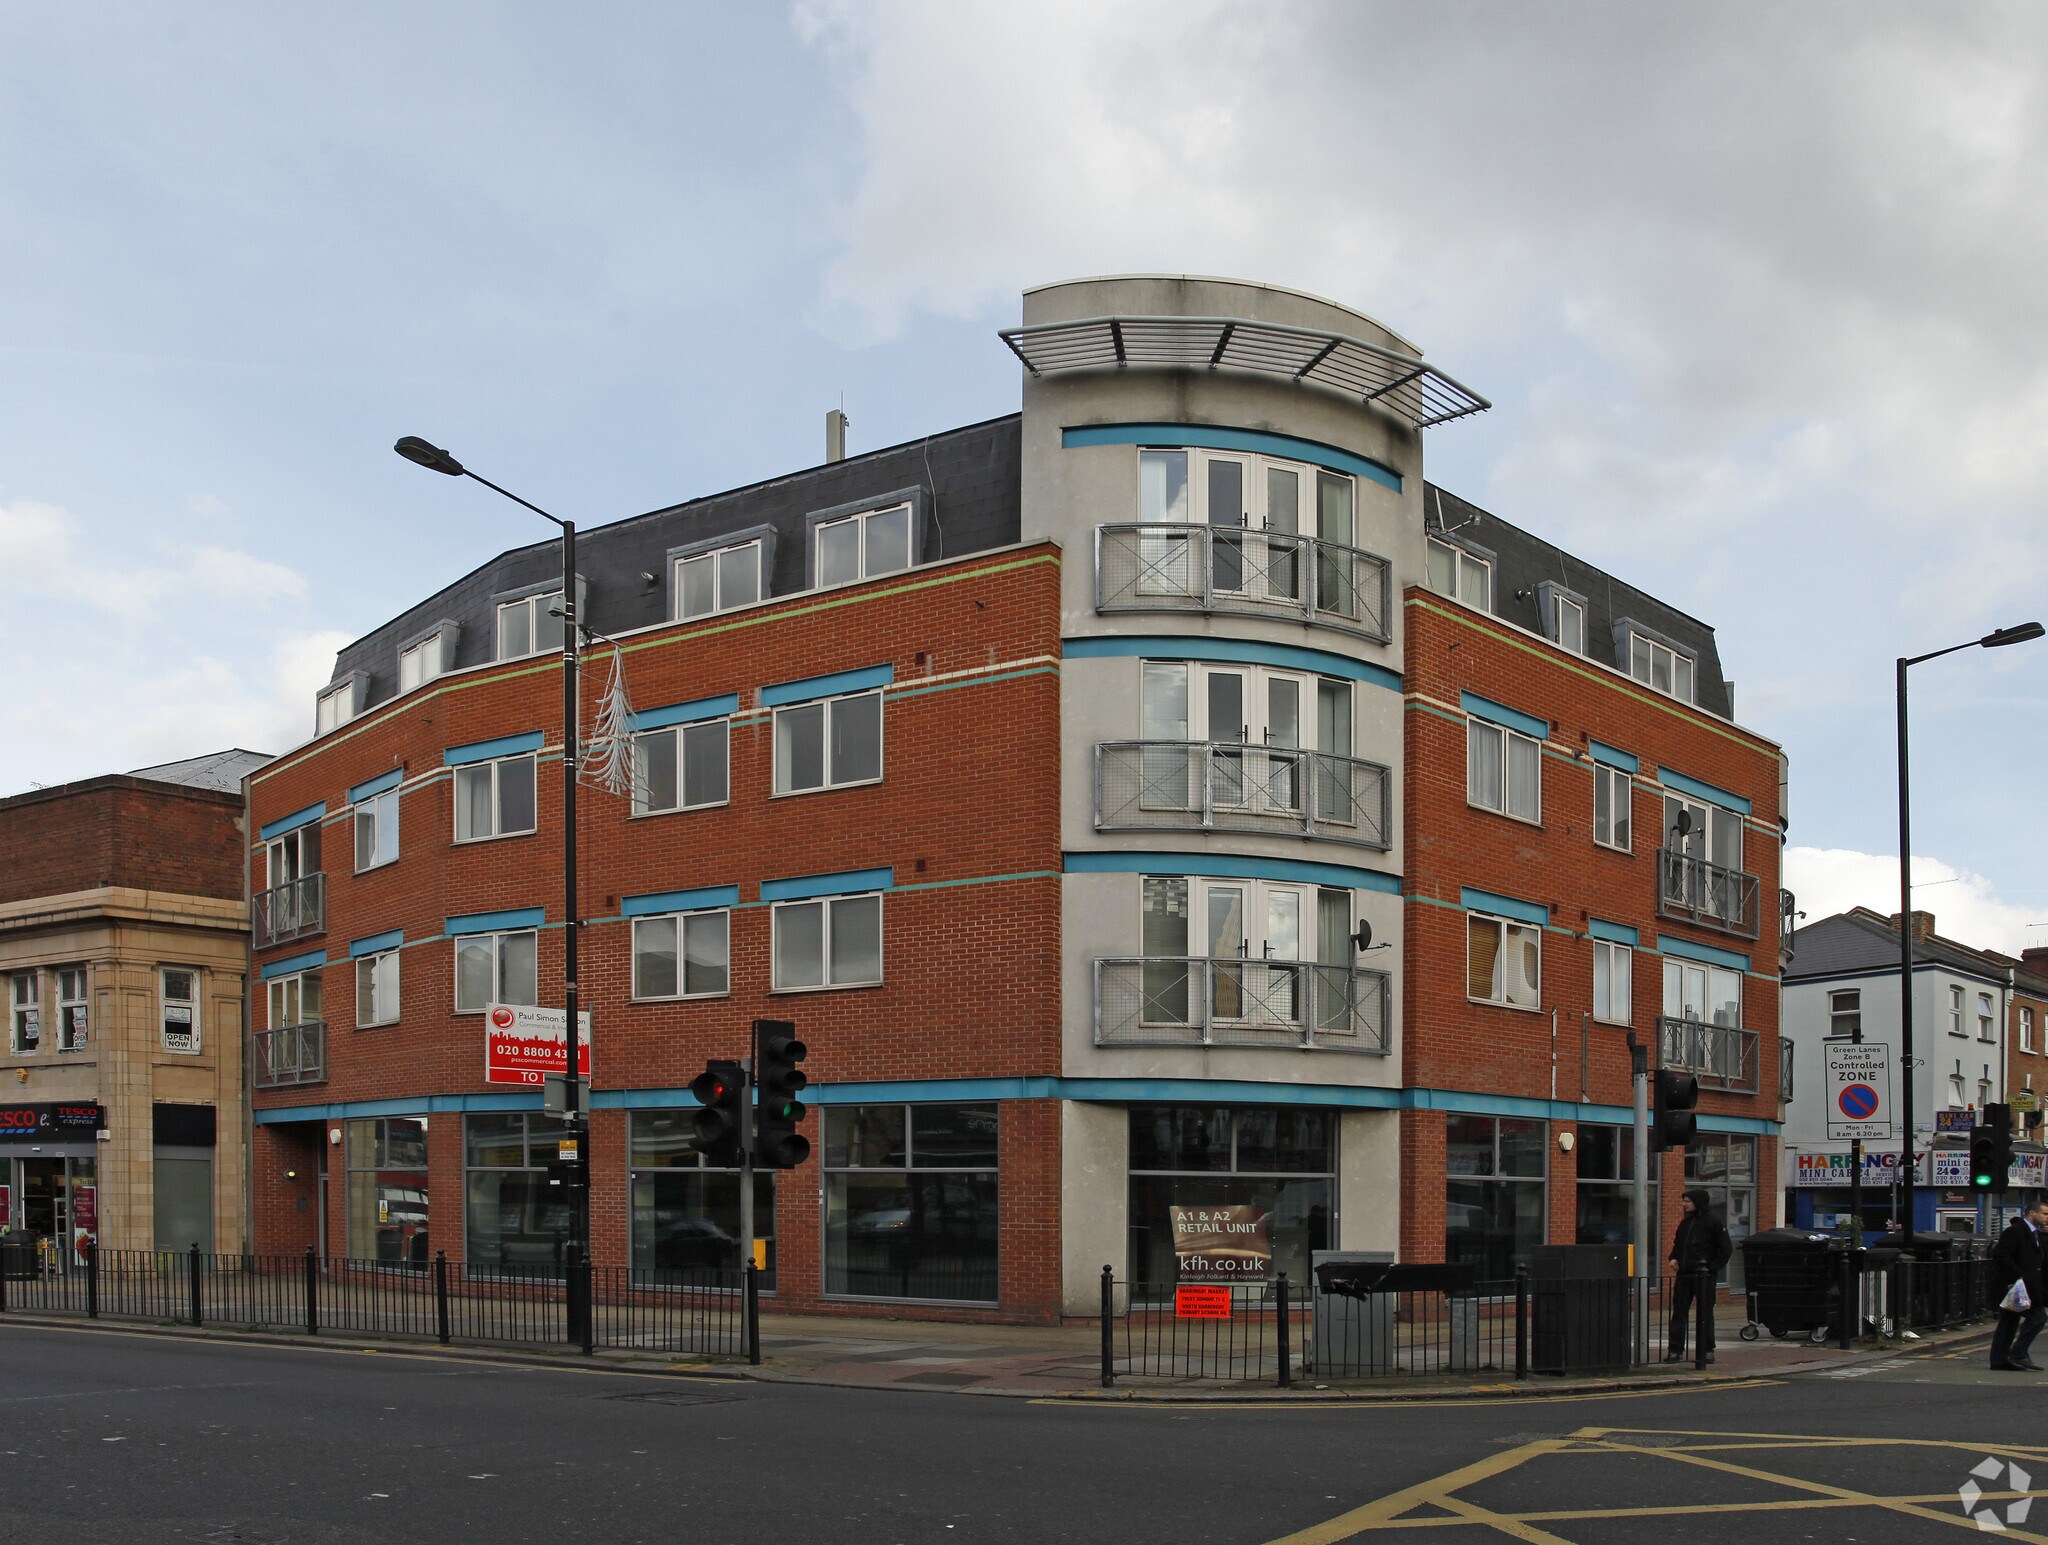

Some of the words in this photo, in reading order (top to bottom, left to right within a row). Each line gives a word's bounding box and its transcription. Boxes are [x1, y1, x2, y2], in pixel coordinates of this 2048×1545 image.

[519, 1012, 534, 1020] Paul
[536, 1014, 559, 1022] Simon
[561, 1016, 586, 1025] Son
[497, 1045, 519, 1055] 020
[524, 1047, 551, 1058] 8800
[554, 1049, 581, 1060] 431
[511, 1058, 567, 1066] psscommercial.com
[1830, 1061, 1885, 1069] Controlled
[521, 1072, 538, 1082] TO
[1838, 1072, 1877, 1081] ZONE
[57, 1107, 97, 1116] TESCO
[0, 1110, 36, 1127] SCO
[1940, 1119, 1952, 1127] 24
[1798, 1153, 1925, 1168] HARRNGY
[1799, 1169, 1829, 1178] MINI
[1832, 1169, 1852, 1177] CAB
[1937, 1167, 1949, 1175] 24
[1177, 1211, 1194, 1221] A1
[1199, 1212, 1209, 1221] &
[1213, 1212, 1231, 1221] A2
[1178, 1224, 1223, 1233] RETAIL
[1226, 1224, 1257, 1233] UNIT
[1180, 1256, 1264, 1271] kfh.co.uk
